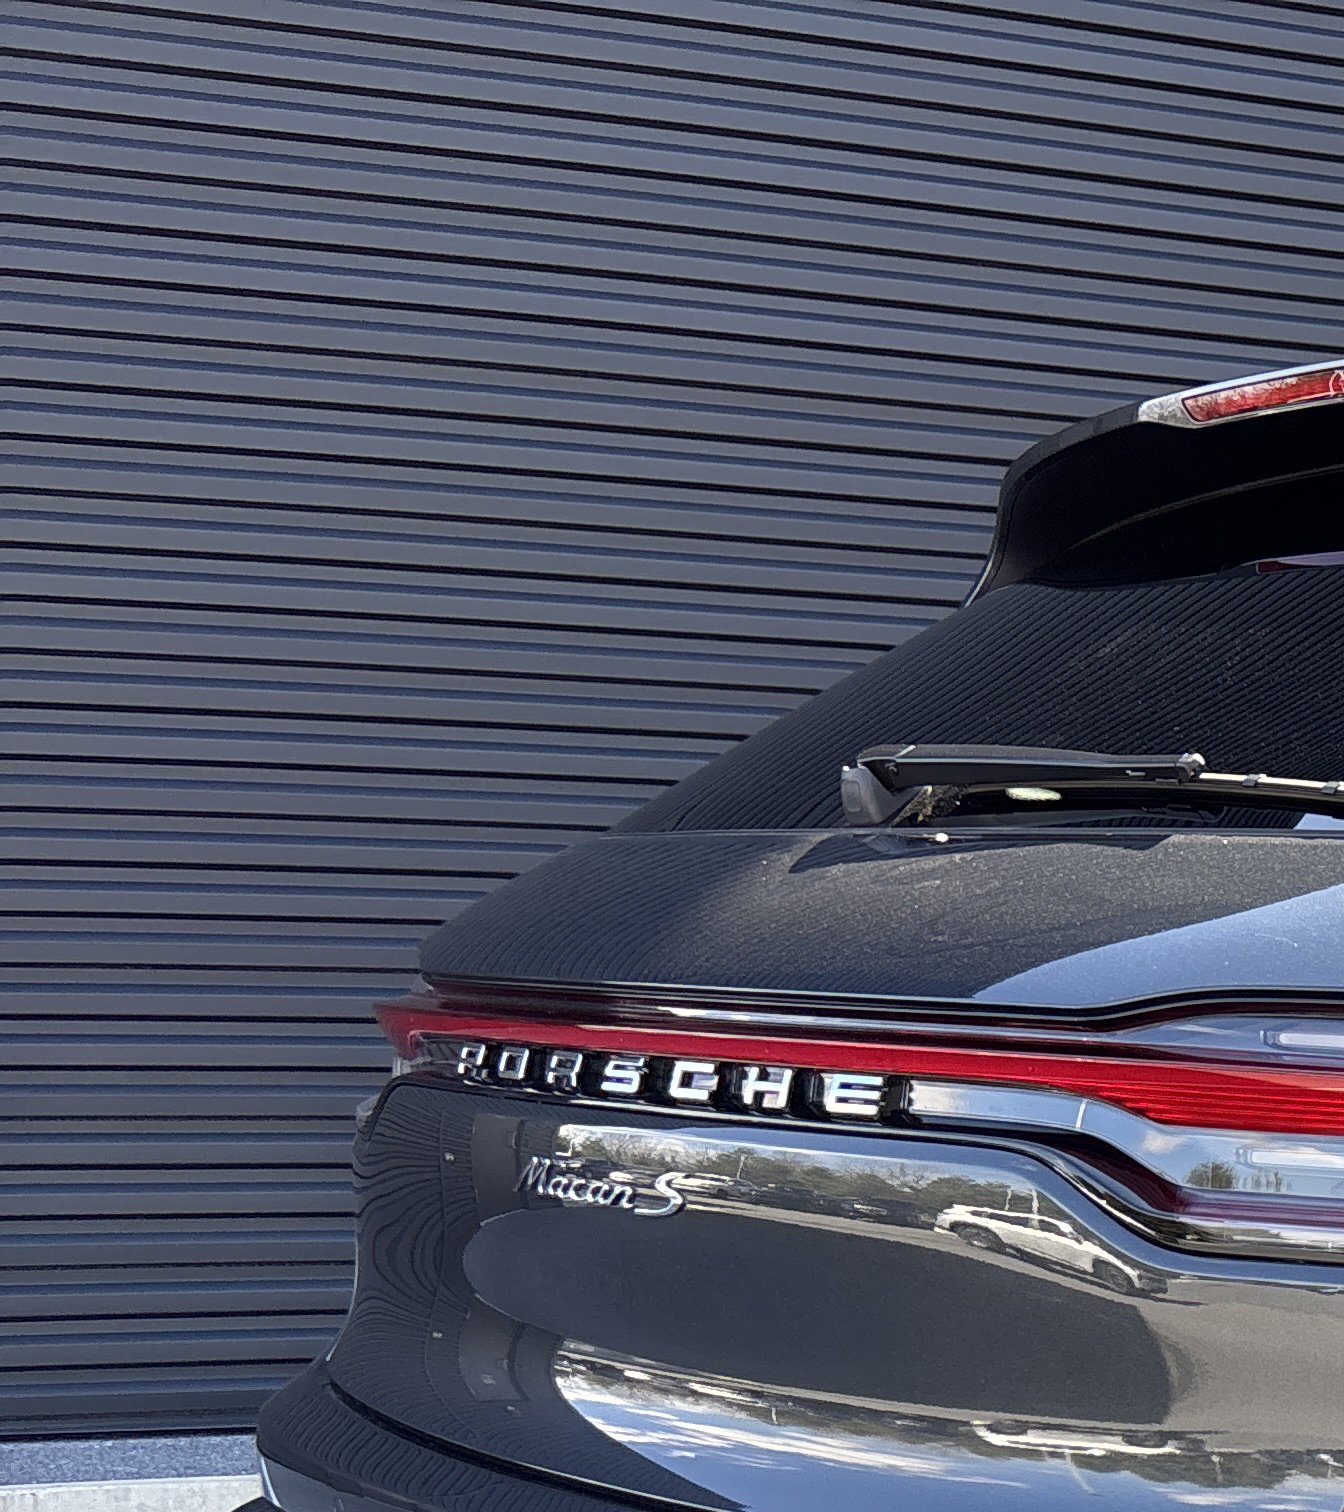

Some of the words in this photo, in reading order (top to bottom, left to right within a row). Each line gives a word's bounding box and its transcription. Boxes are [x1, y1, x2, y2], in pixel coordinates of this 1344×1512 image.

[457, 1042, 885, 1115] PORSCHE
[514, 1156, 634, 1209] Macan
[634, 1171, 687, 1216] S
